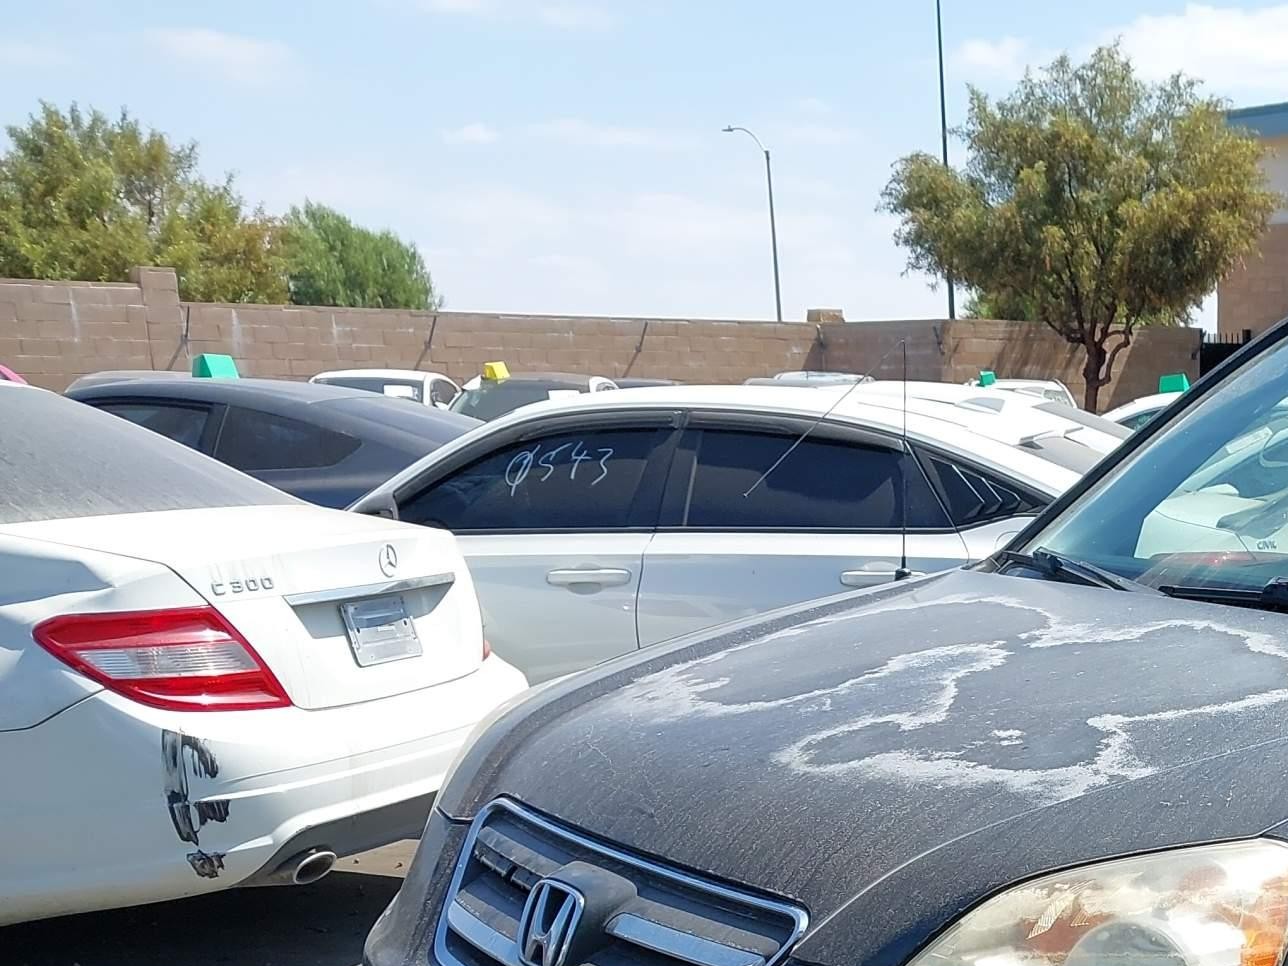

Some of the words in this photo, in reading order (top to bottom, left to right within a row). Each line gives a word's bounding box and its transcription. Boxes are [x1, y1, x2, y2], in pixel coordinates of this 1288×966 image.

[505, 440, 614, 497] 0543
[210, 582, 227, 596] C
[229, 576, 275, 594] 300
